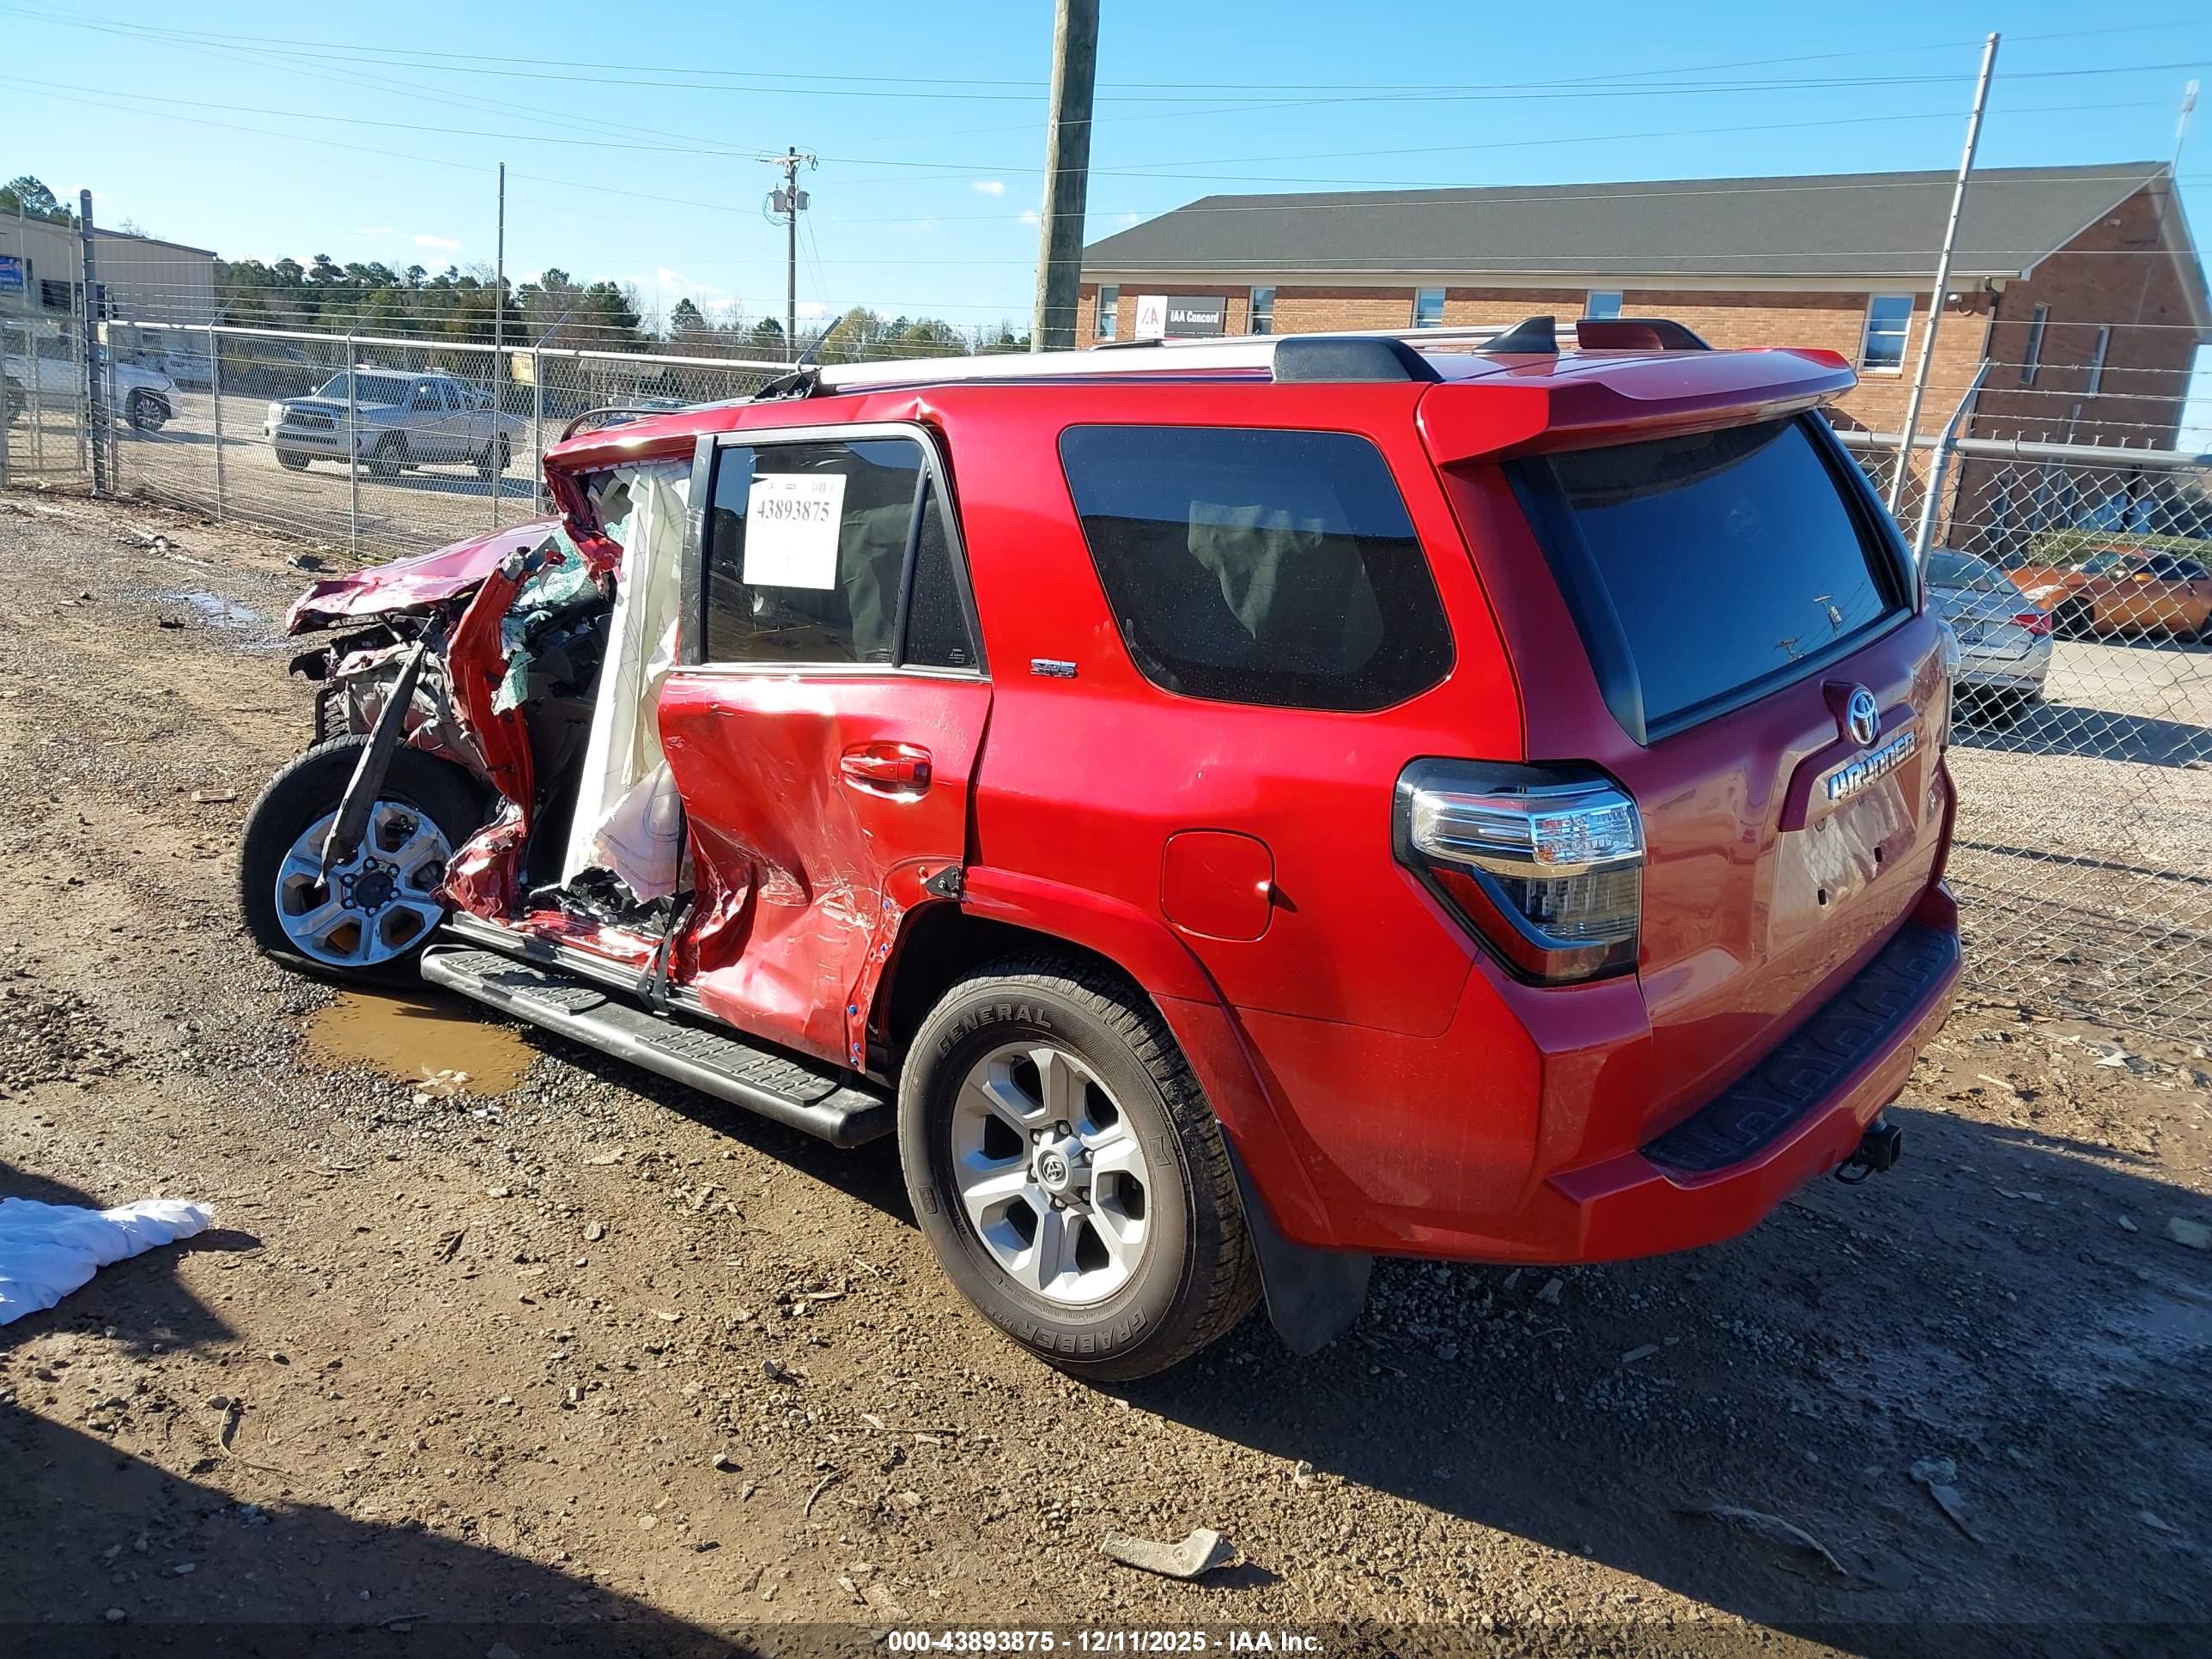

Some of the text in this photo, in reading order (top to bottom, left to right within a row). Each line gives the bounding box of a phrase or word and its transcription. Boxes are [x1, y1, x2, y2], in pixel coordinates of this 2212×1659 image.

[1170, 310, 1219, 324] IAA Concord
[757, 499, 830, 522] 43893875
[936, 1003, 1052, 1059] GENERAL
[1018, 1304, 1148, 1354] GRABBER
